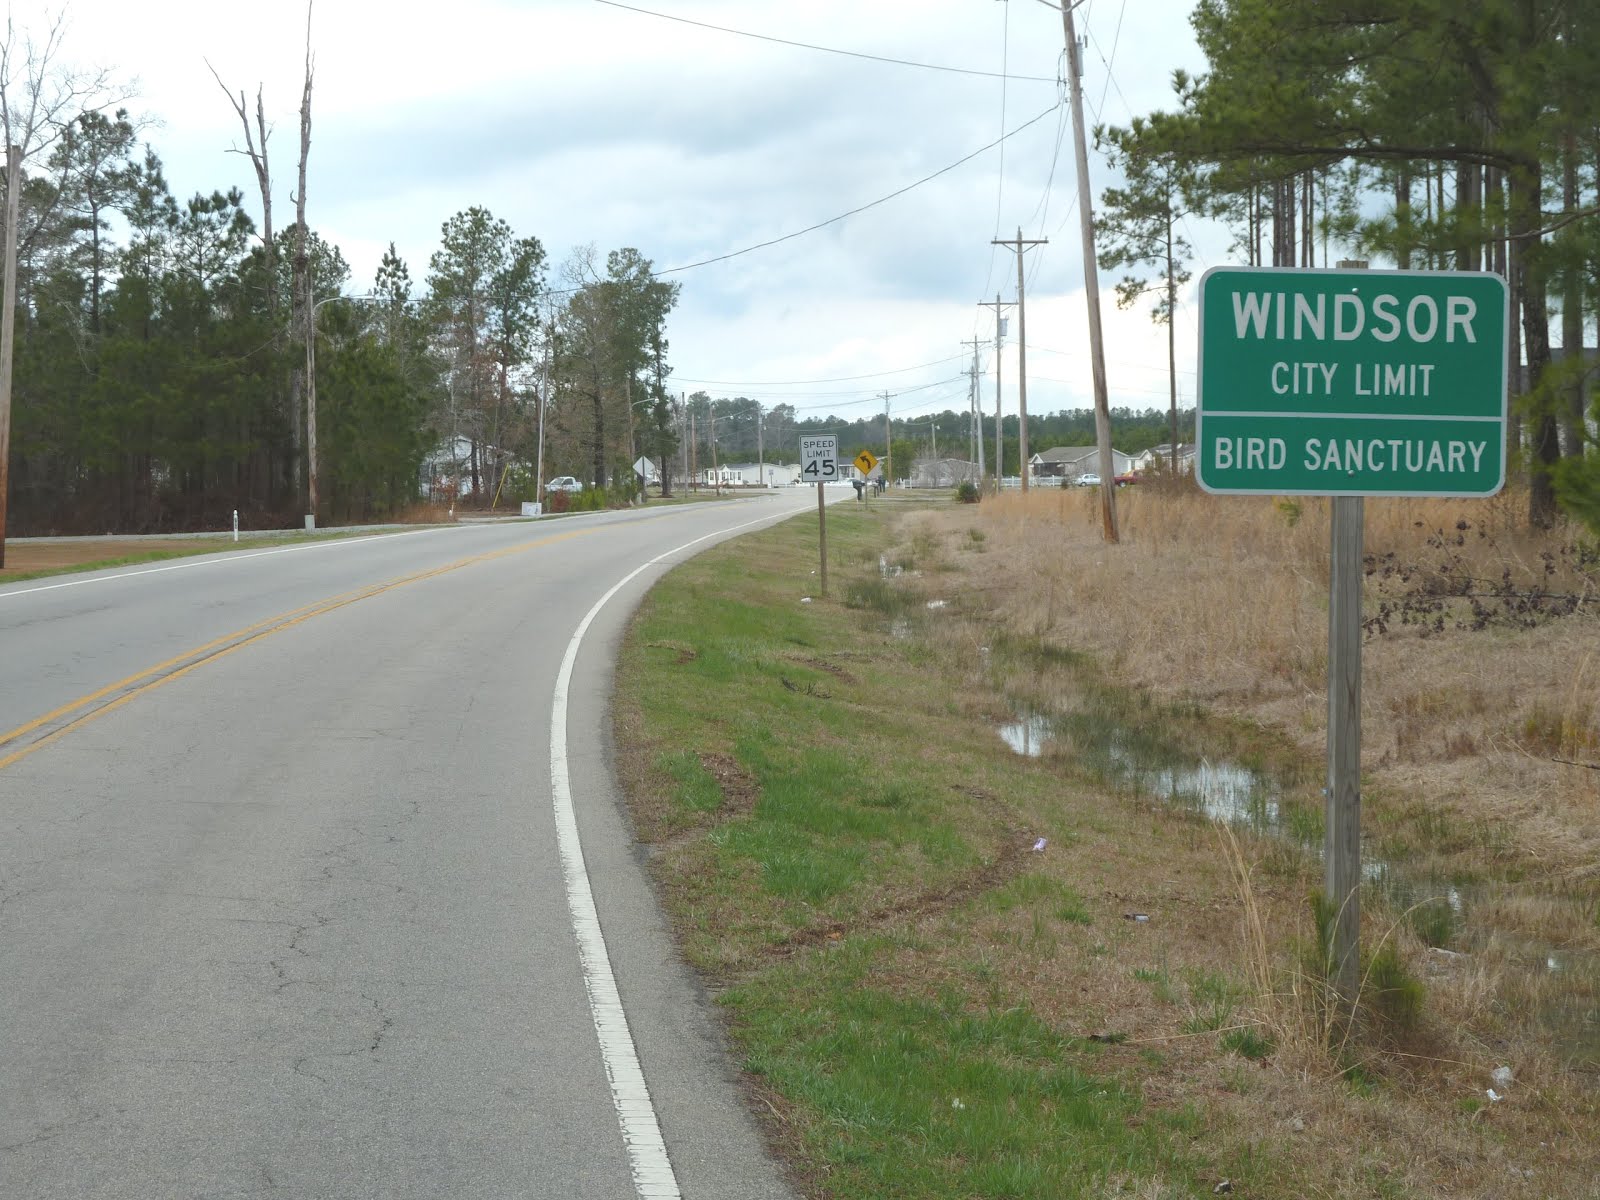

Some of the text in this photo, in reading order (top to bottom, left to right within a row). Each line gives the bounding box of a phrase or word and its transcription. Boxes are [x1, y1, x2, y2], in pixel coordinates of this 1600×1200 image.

[1231, 291, 1478, 344] WINDSOR
[1271, 361, 1435, 397] CITY LIMIT
[803, 440, 834, 448] SPEED
[807, 450, 831, 458] LIMIT
[1214, 437, 1487, 473] BIRD SANCTUARY
[804, 459, 835, 476] 45
